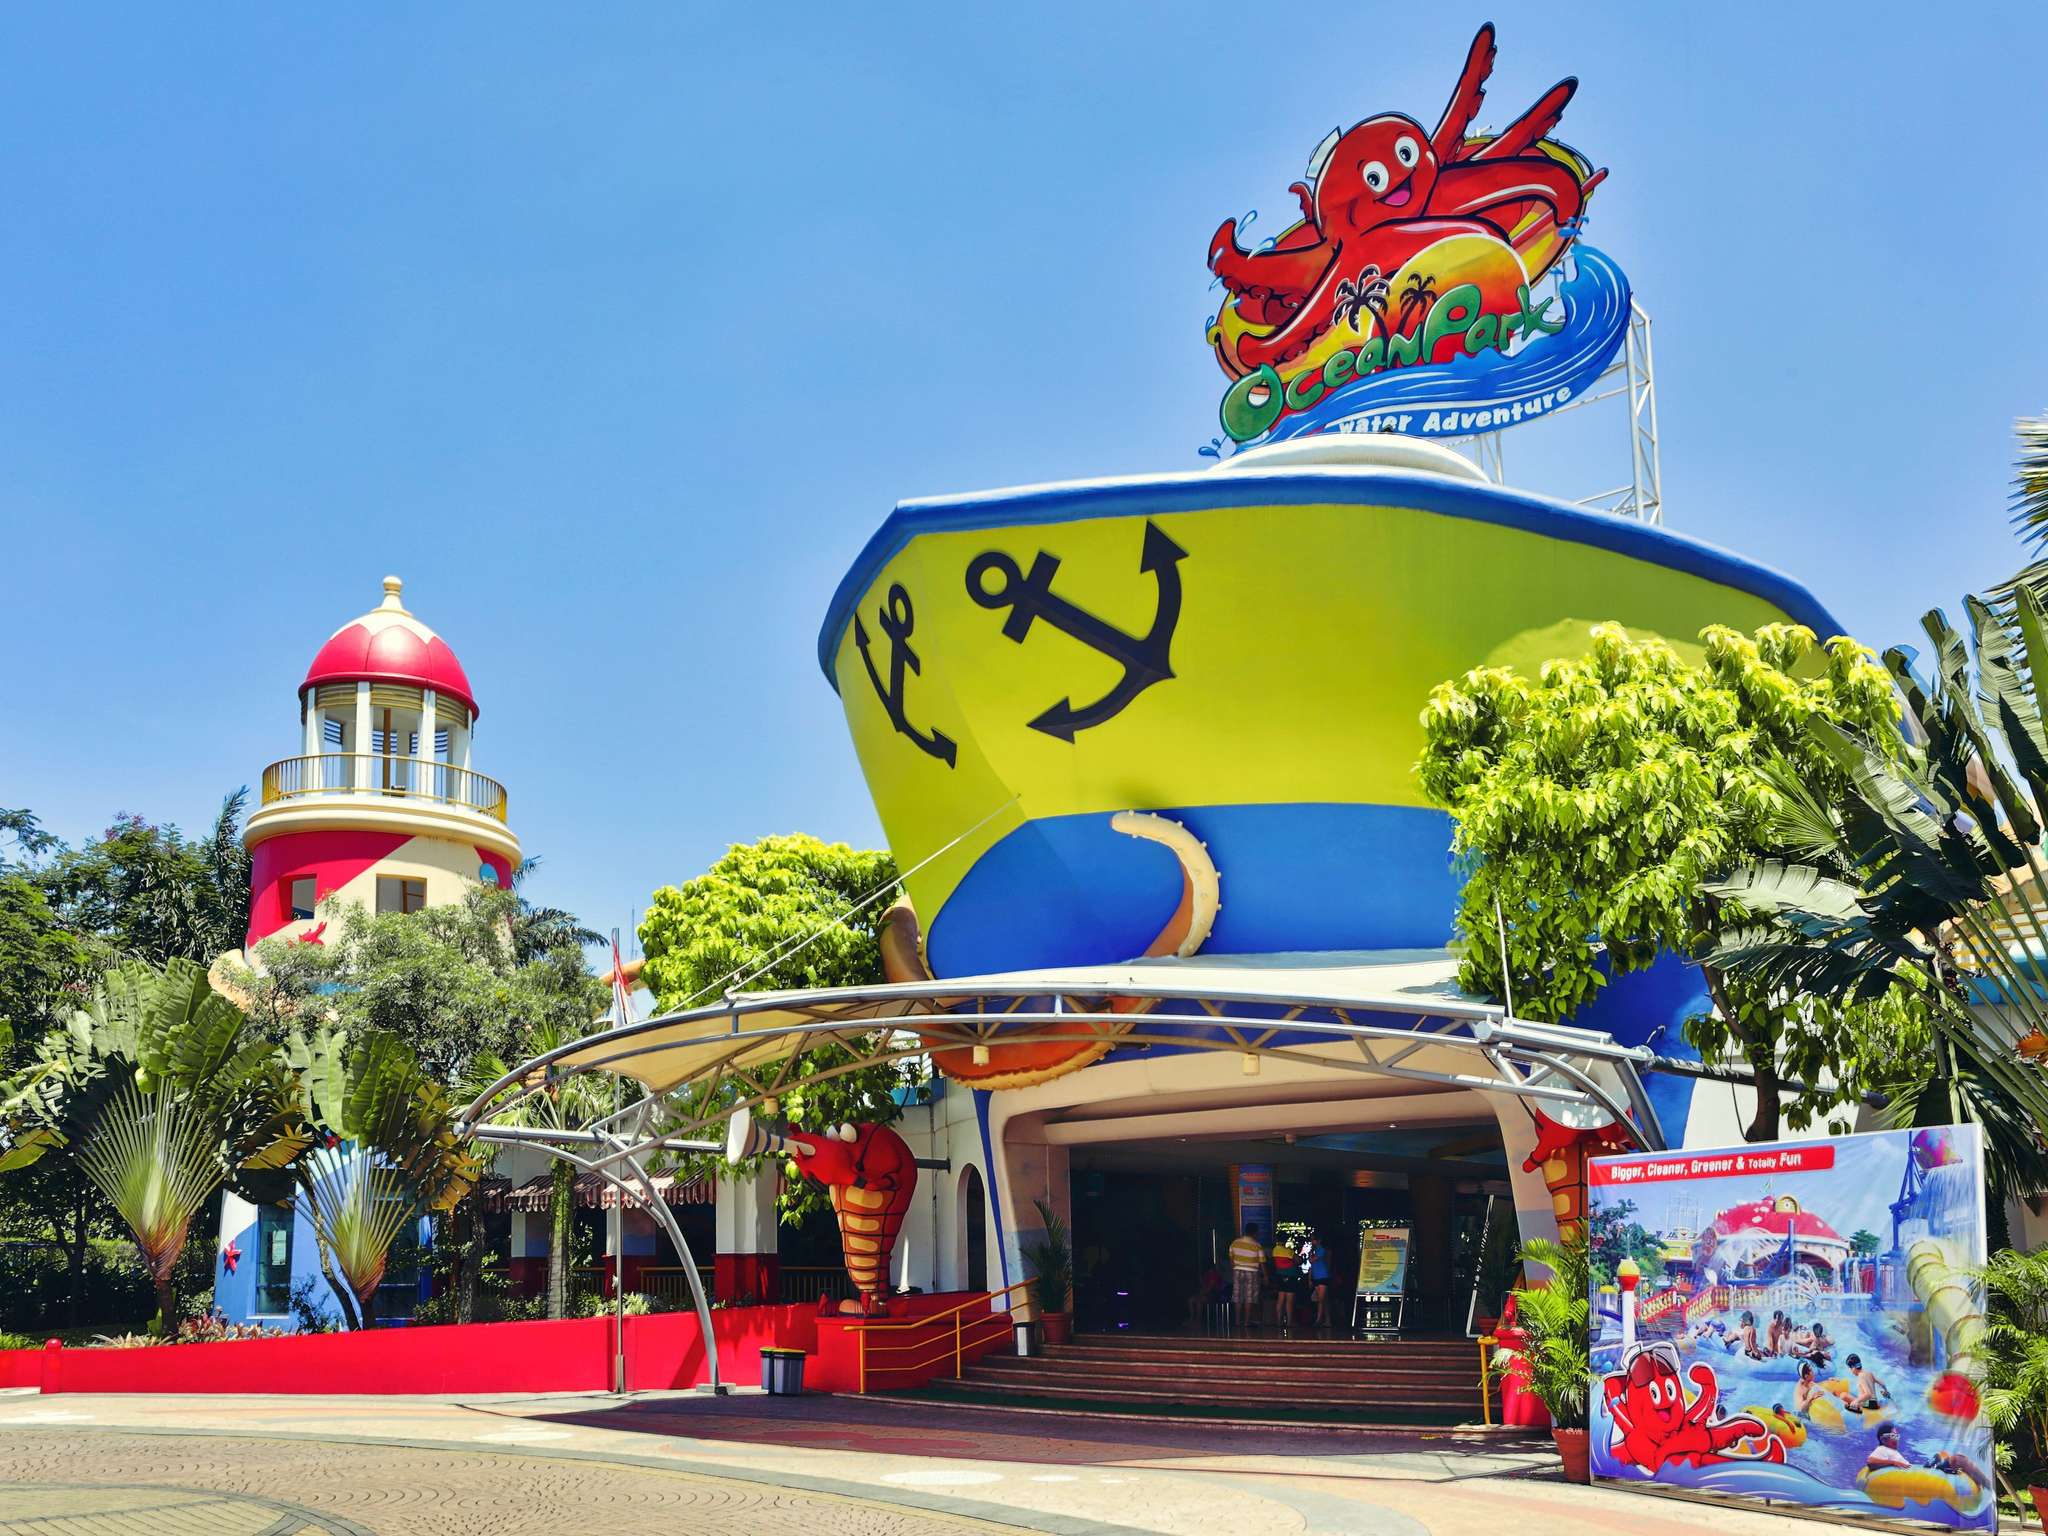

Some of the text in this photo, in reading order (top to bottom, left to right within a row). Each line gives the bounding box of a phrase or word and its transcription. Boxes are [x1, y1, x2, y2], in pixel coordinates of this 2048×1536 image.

[1422, 387, 1572, 432] Adventure
[1611, 1152, 1802, 1181] Bigger, Cleaner, Greener & Totally Fun
